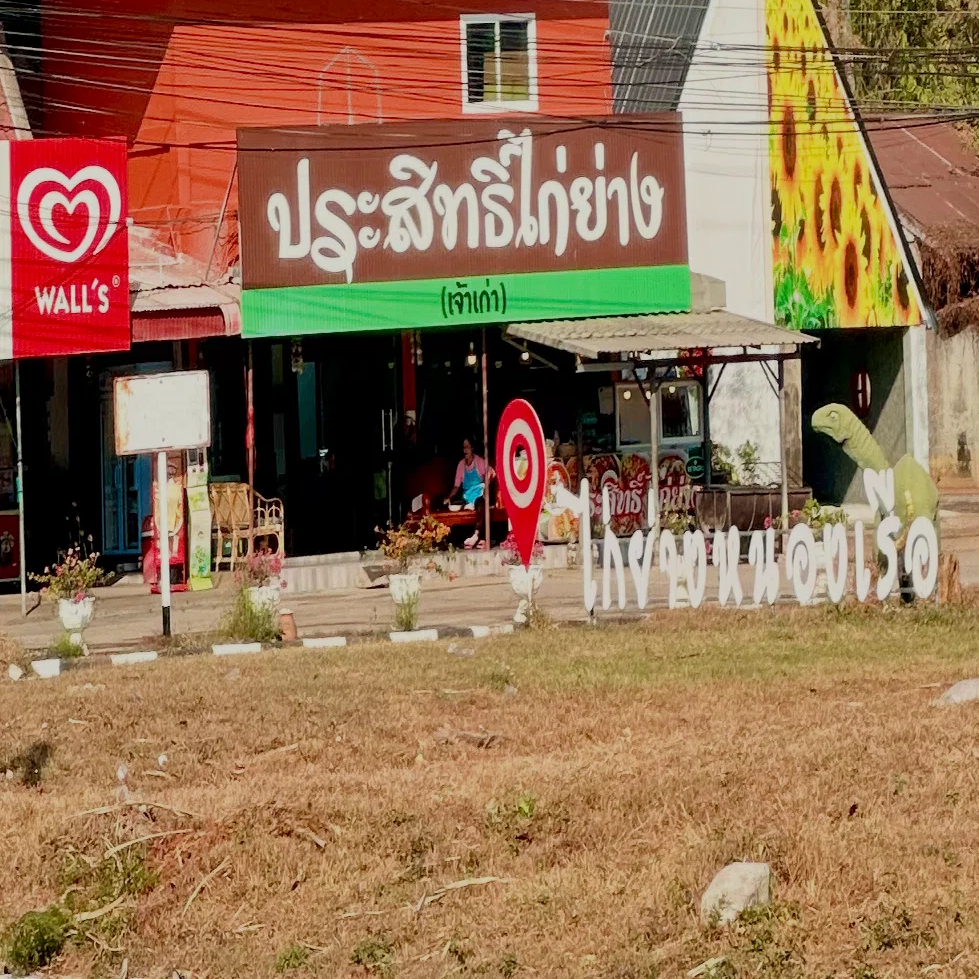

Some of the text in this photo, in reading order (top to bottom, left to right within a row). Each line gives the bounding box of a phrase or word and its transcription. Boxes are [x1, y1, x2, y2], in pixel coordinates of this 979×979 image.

[267, 128, 664, 284] ประสิทธิ์ไก่ย่าง
[35, 278, 109, 315] WALL'S
[441, 279, 506, 318] (เจ้าเก่า)
